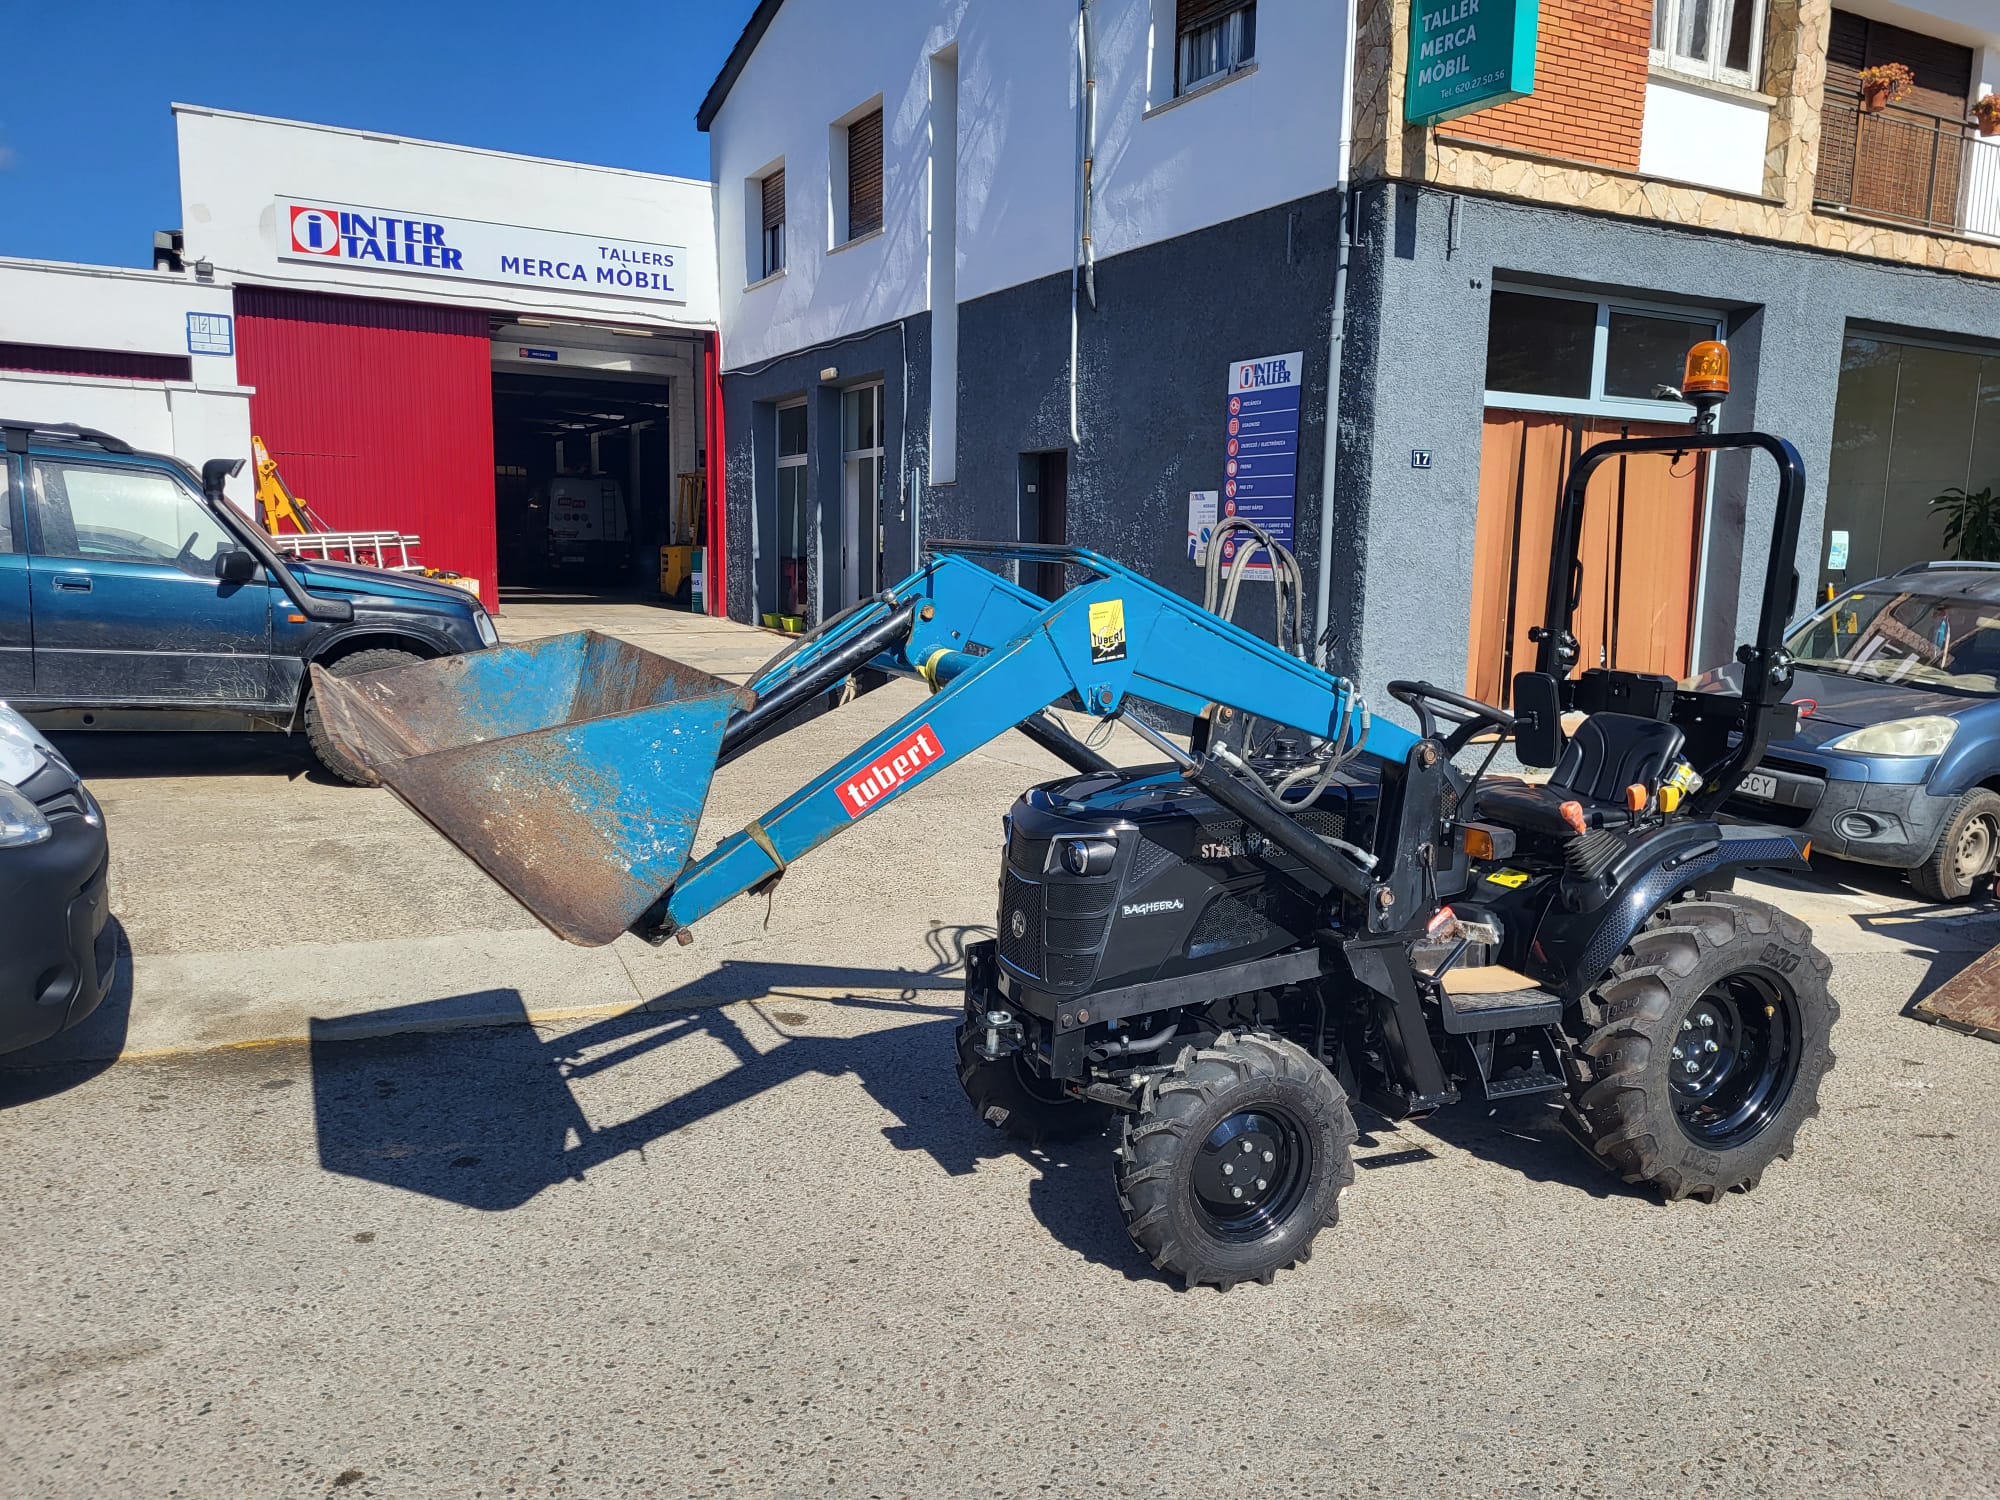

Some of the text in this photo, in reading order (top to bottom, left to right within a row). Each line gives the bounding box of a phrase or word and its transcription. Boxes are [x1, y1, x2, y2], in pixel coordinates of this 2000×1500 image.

[1422, 0, 1479, 32] TALLER
[1420, 24, 1477, 60] MERCA
[1418, 54, 1470, 87] MÒBIL
[1455, 69, 1505, 94] 620.27.50.56
[340, 212, 446, 246] INTER
[341, 235, 464, 271] TALLER
[598, 246, 675, 267] TALLERS
[501, 255, 675, 292] MERCA MÒBIL
[1254, 360, 1287, 376] INTER
[1254, 371, 1291, 387] TALLER
[1415, 453, 1430, 465] 17
[1092, 628, 1123, 646] TUBERT
[847, 733, 936, 807] tubert
[1123, 899, 1183, 916] BAGHEERA
